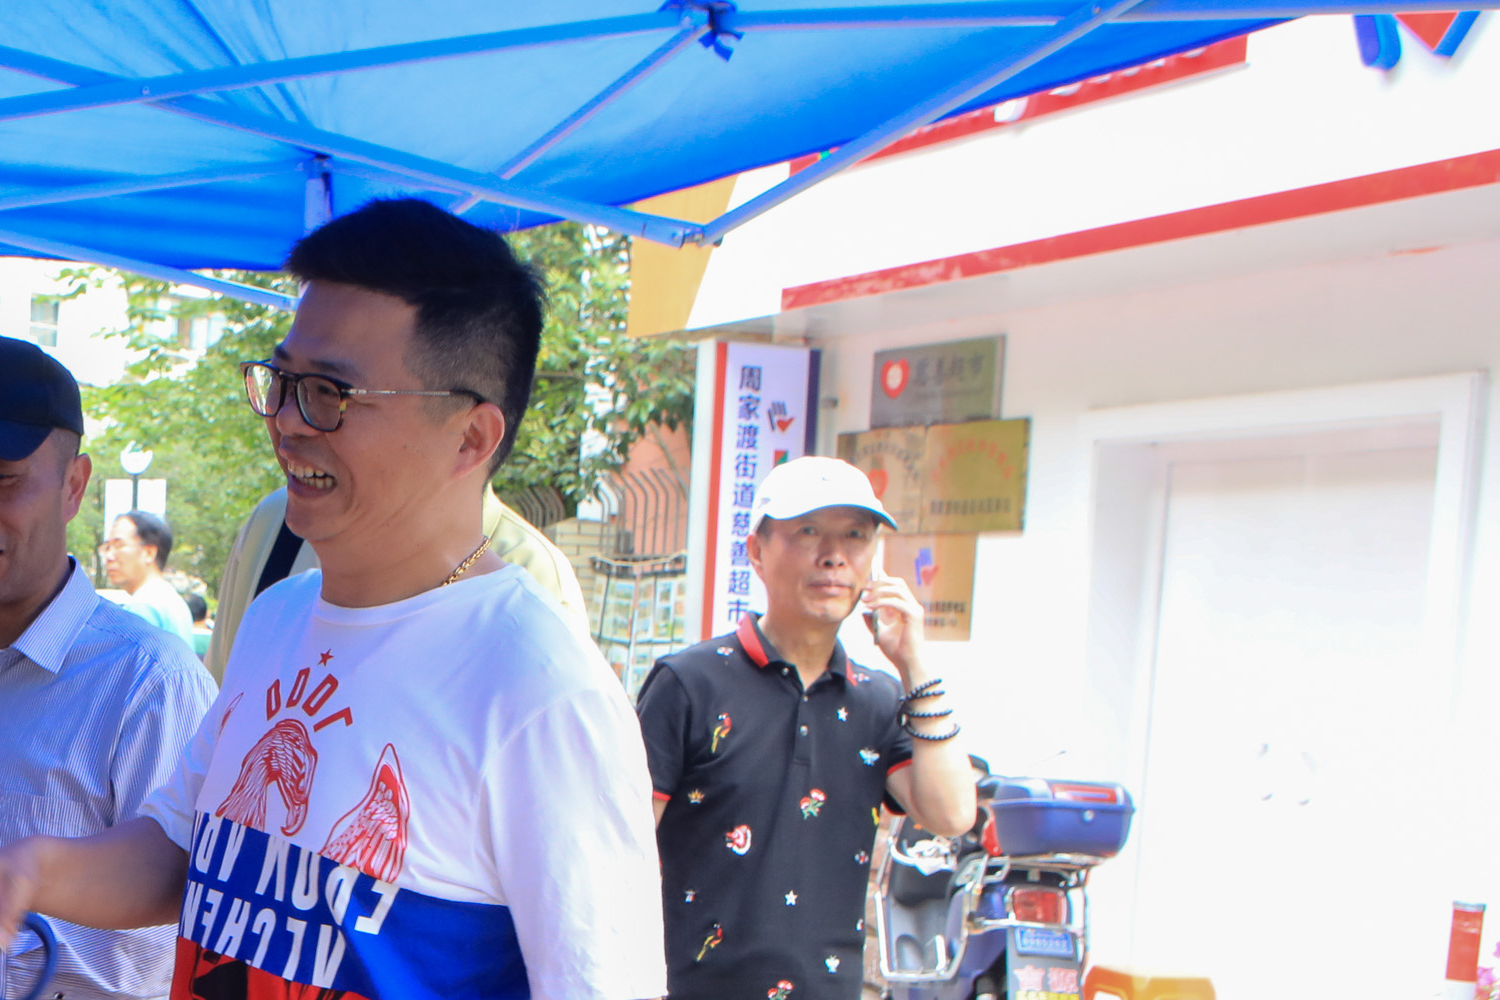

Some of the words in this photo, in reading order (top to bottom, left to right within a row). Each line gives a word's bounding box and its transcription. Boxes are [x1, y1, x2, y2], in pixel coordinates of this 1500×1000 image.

[728, 365, 763, 623] 周家渡街道慈善超市
